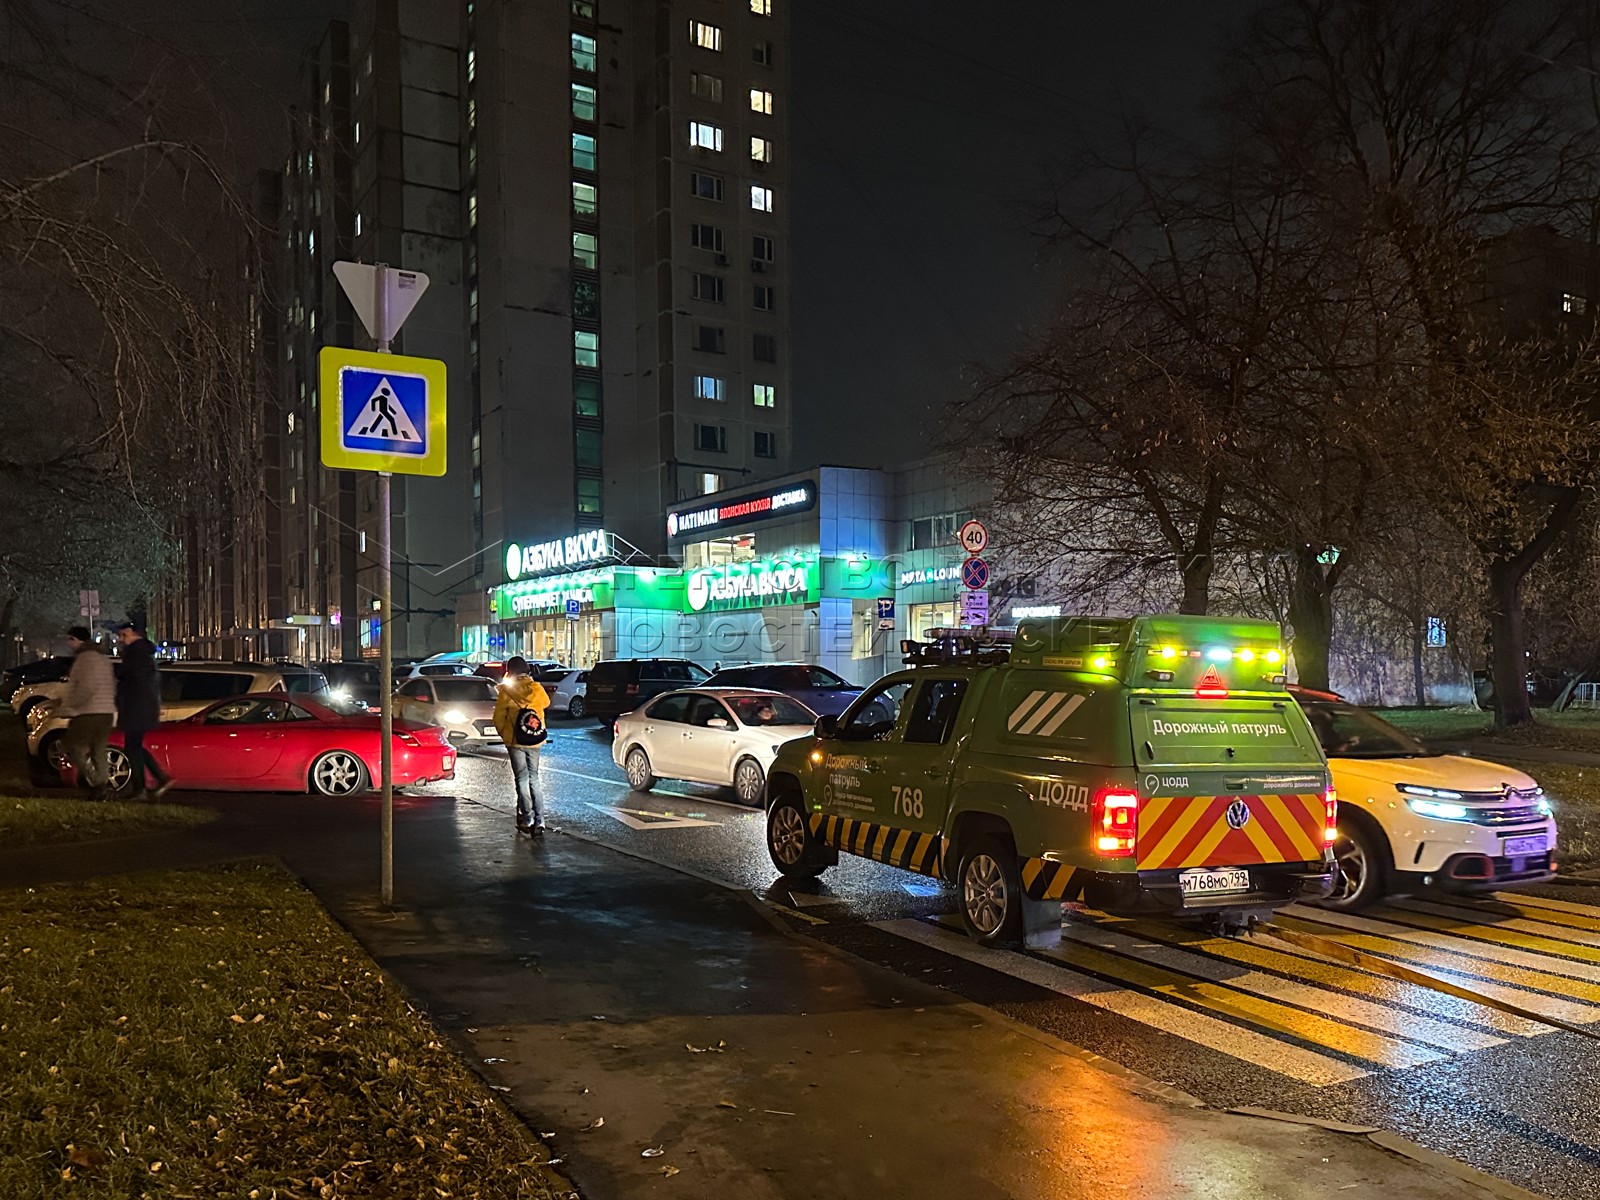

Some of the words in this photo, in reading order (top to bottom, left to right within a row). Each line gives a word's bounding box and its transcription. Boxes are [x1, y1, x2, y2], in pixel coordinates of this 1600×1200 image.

[720, 503, 750, 520] ЯПОНСКАЯ
[750, 498, 771, 513] КУХНЯ
[771, 488, 807, 511] ДОСТАВКА
[966, 531, 982, 544] 40
[522, 539, 565, 573] АЗБУКА
[565, 528, 607, 564] ВКУСА
[934, 564, 965, 580] LOUN
[709, 574, 759, 601] АЗБУКА
[759, 567, 808, 597] ВКУСА
[1152, 719, 1228, 736] Дорожный
[1232, 723, 1287, 737] патруль
[826, 753, 868, 770] Дорожный
[829, 773, 861, 789] патруль
[1162, 776, 1189, 788] ЦОДД
[891, 785, 924, 819] 768
[1039, 780, 1089, 813] ЦОДД
[1183, 875, 1228, 891] М768МО
[1229, 872, 1246, 884] 799
